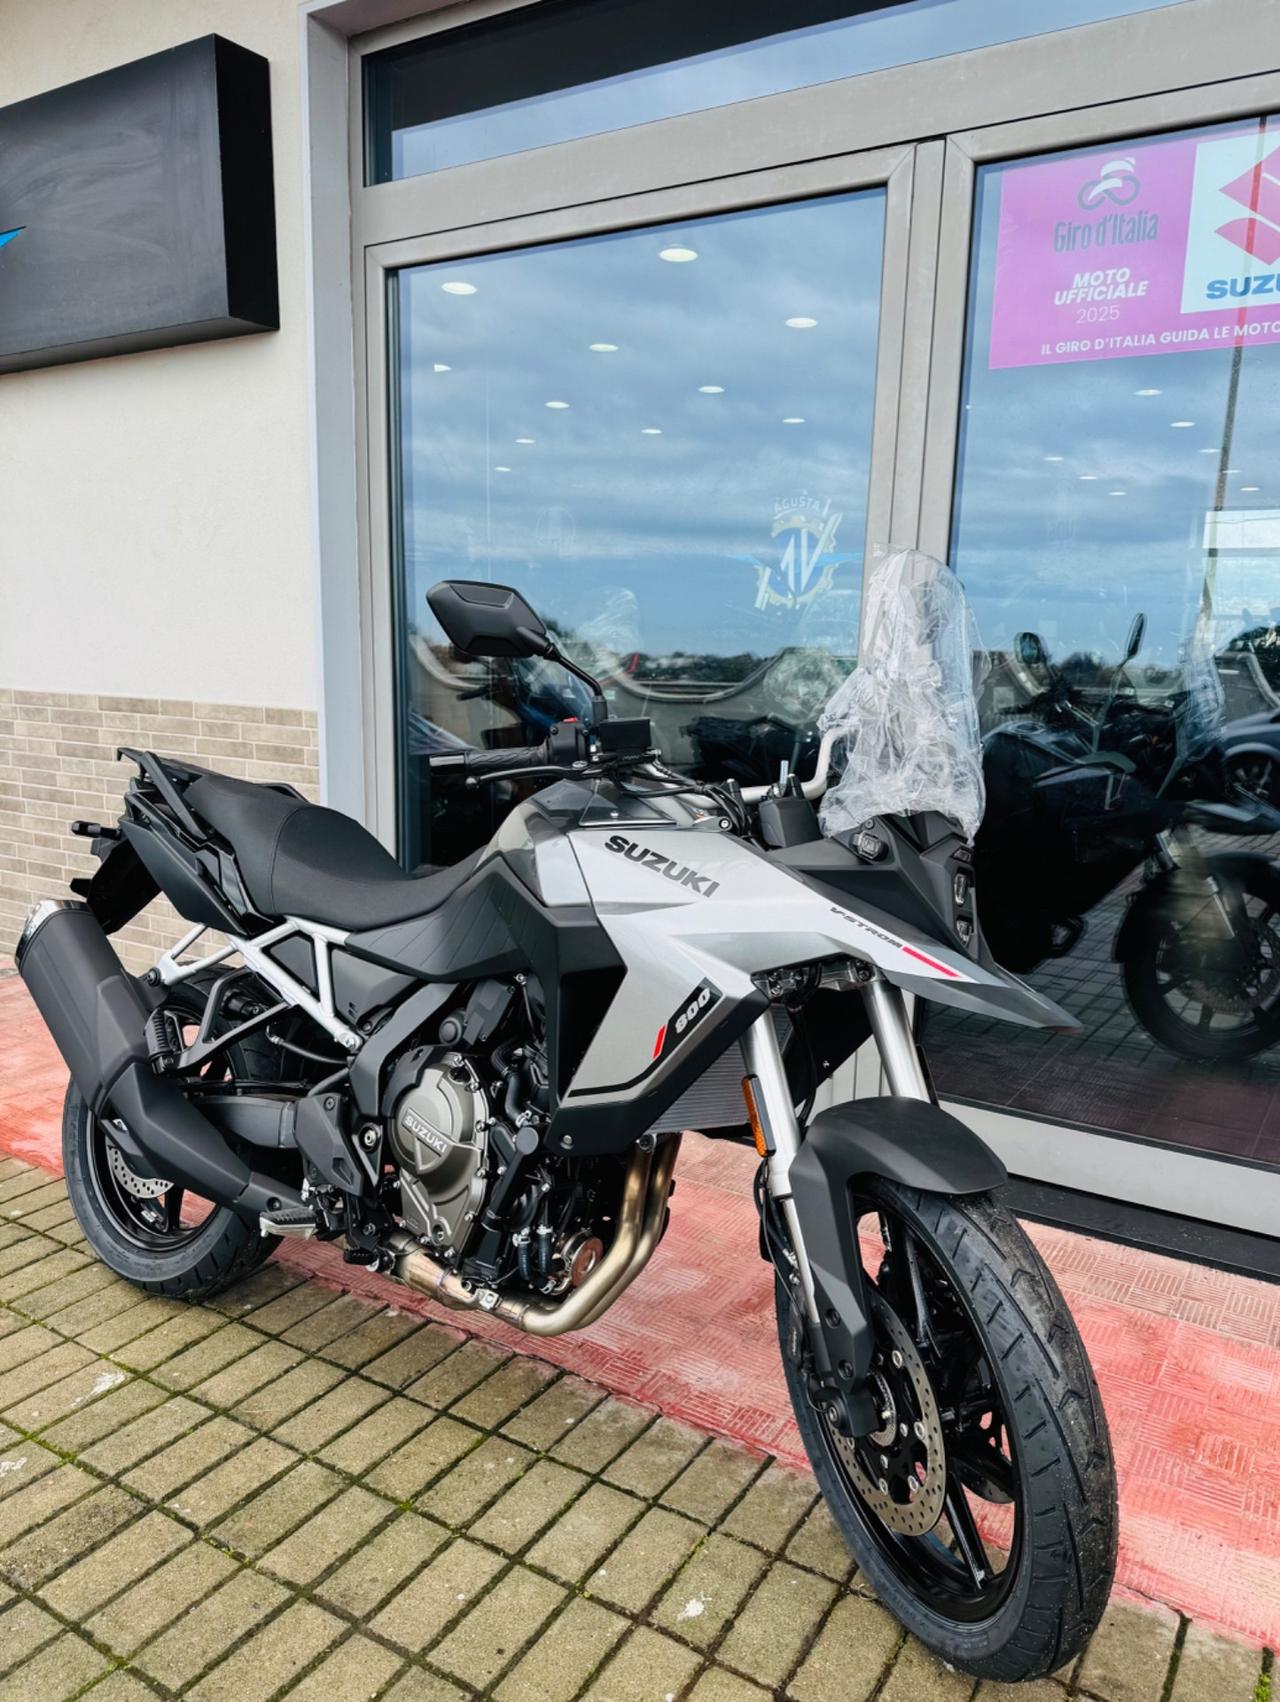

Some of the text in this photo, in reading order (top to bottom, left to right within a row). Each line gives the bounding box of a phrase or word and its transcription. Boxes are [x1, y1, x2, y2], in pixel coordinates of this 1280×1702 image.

[1053, 220, 1092, 252] Giro
[1072, 267, 1131, 289] MOTO
[1206, 273, 1280, 299] SUZ
[1054, 280, 1149, 305] UFFICIALE
[1076, 305, 1120, 324] 2025
[1041, 343, 1051, 355] IL
[1056, 340, 1091, 354] GIRO
[1160, 328, 1209, 344] GUIDA
[1214, 326, 1230, 339] LE
[774, 496, 820, 513] AGUSTA
[604, 835, 720, 898] SUZUKI
[675, 987, 711, 1034] 800
[405, 1115, 447, 1153] SUZUKI
